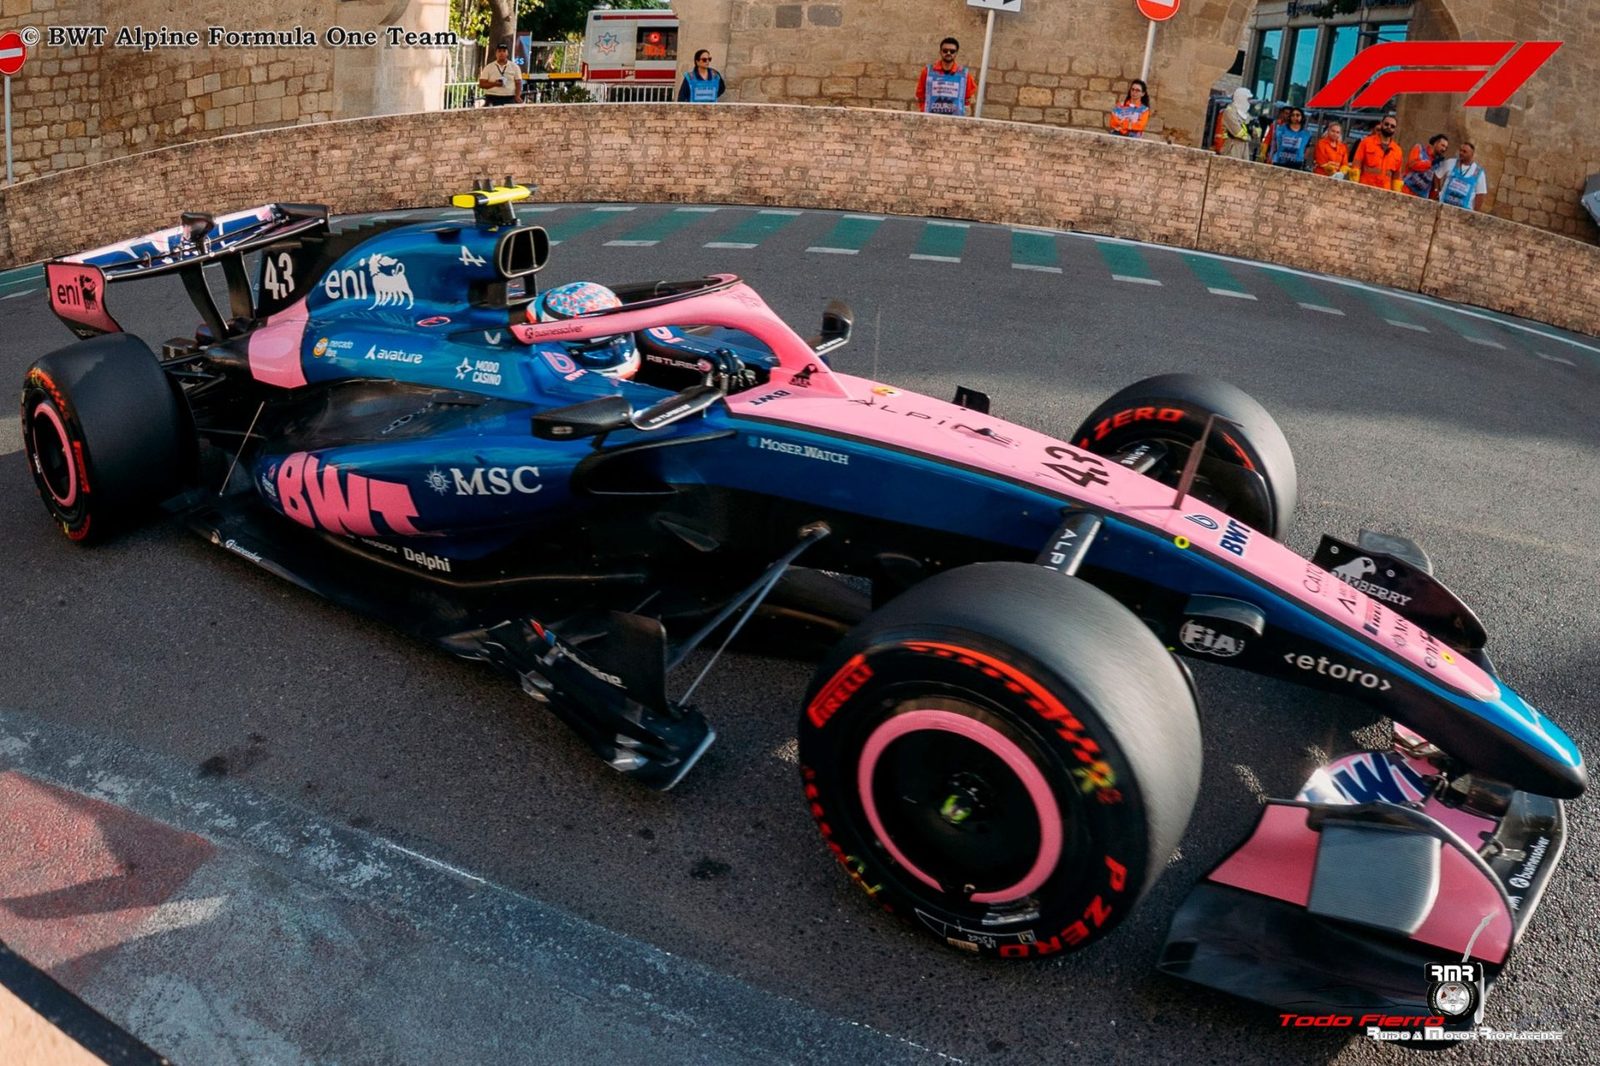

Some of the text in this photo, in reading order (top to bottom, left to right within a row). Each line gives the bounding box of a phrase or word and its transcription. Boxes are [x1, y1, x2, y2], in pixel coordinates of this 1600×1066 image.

[57, 277, 80, 306] eni
[264, 252, 295, 300] 43
[325, 258, 368, 300] eni
[377, 349, 423, 364] avature
[475, 360, 500, 373] MODO
[472, 372, 501, 386] CASINO
[1093, 406, 1185, 441] ZERO
[450, 465, 543, 496] MSC
[1041, 445, 1110, 488] 43
[277, 451, 422, 537] BWT
[1042, 528, 1078, 571] ALPI
[1219, 519, 1252, 557] BWT
[402, 546, 451, 573] Delphi
